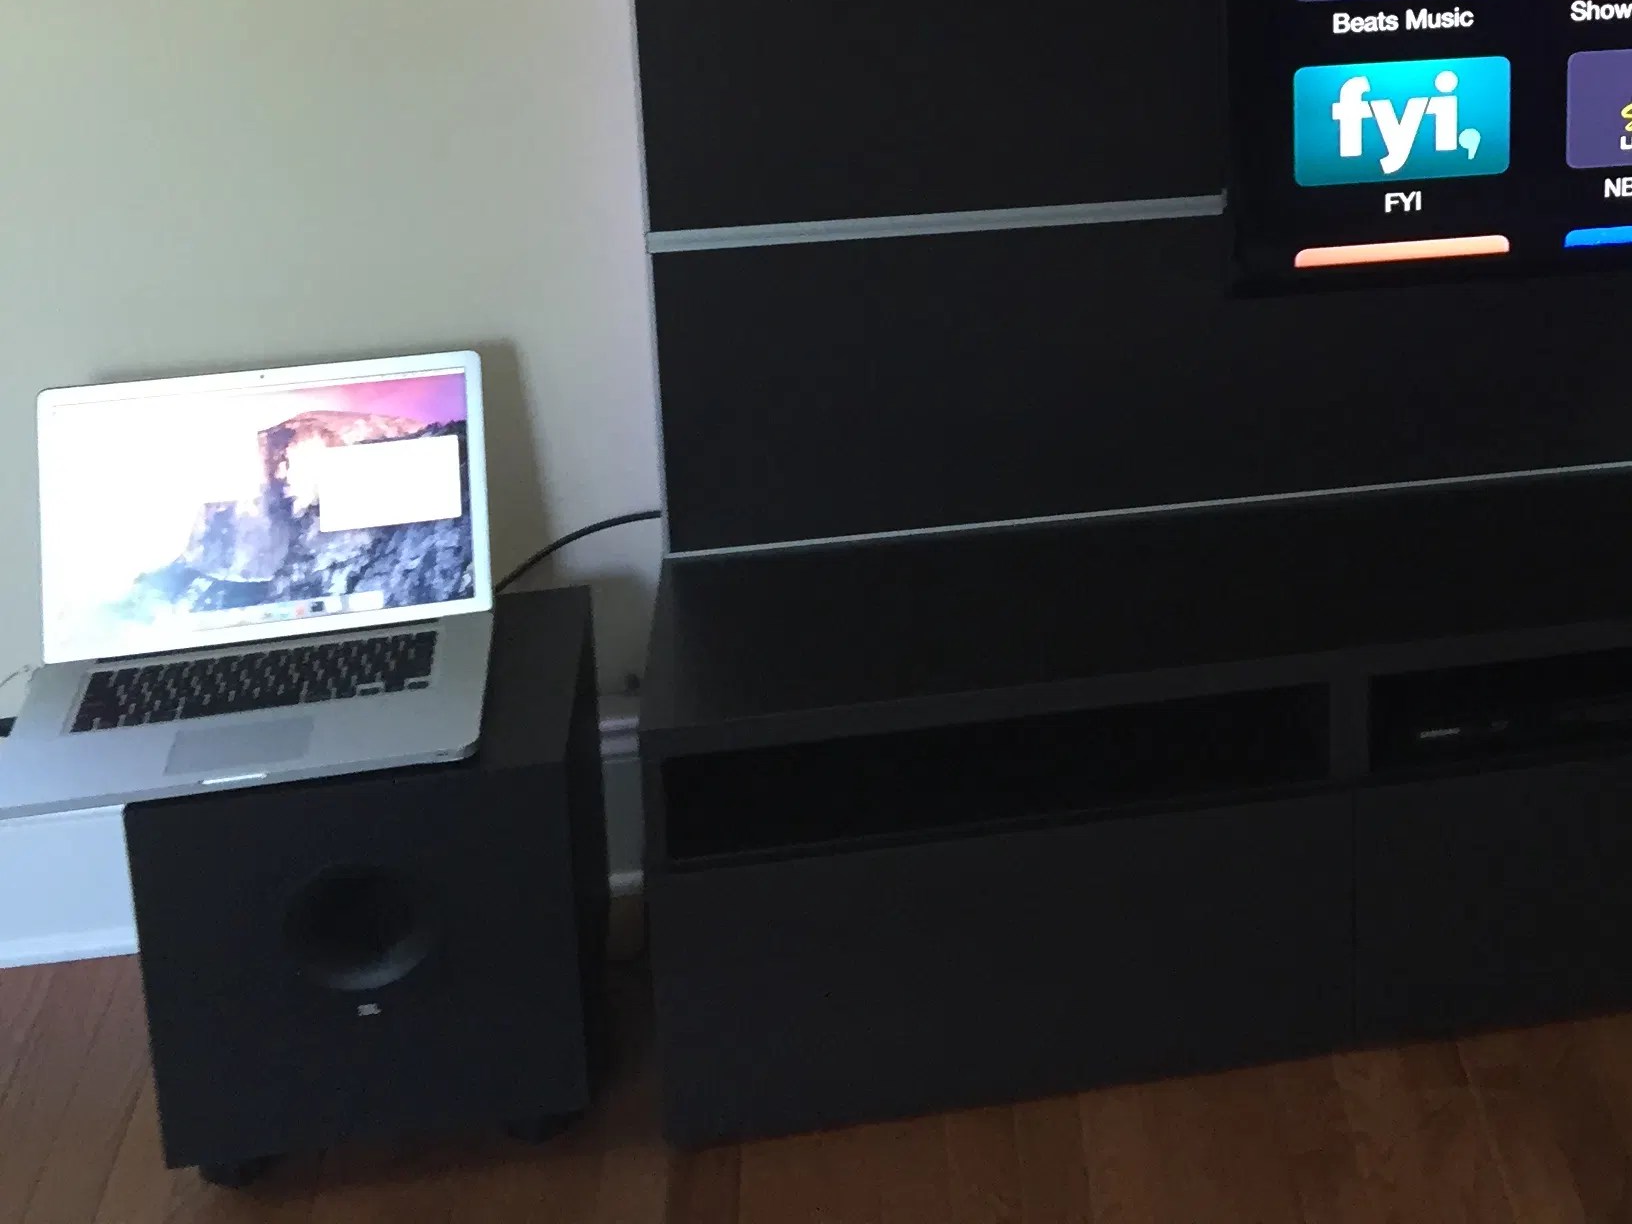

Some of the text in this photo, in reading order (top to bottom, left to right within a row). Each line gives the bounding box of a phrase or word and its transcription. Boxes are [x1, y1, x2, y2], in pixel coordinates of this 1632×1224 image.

[1332, 6, 1475, 34] Beats Music
[1384, 190, 1422, 213] FYI
